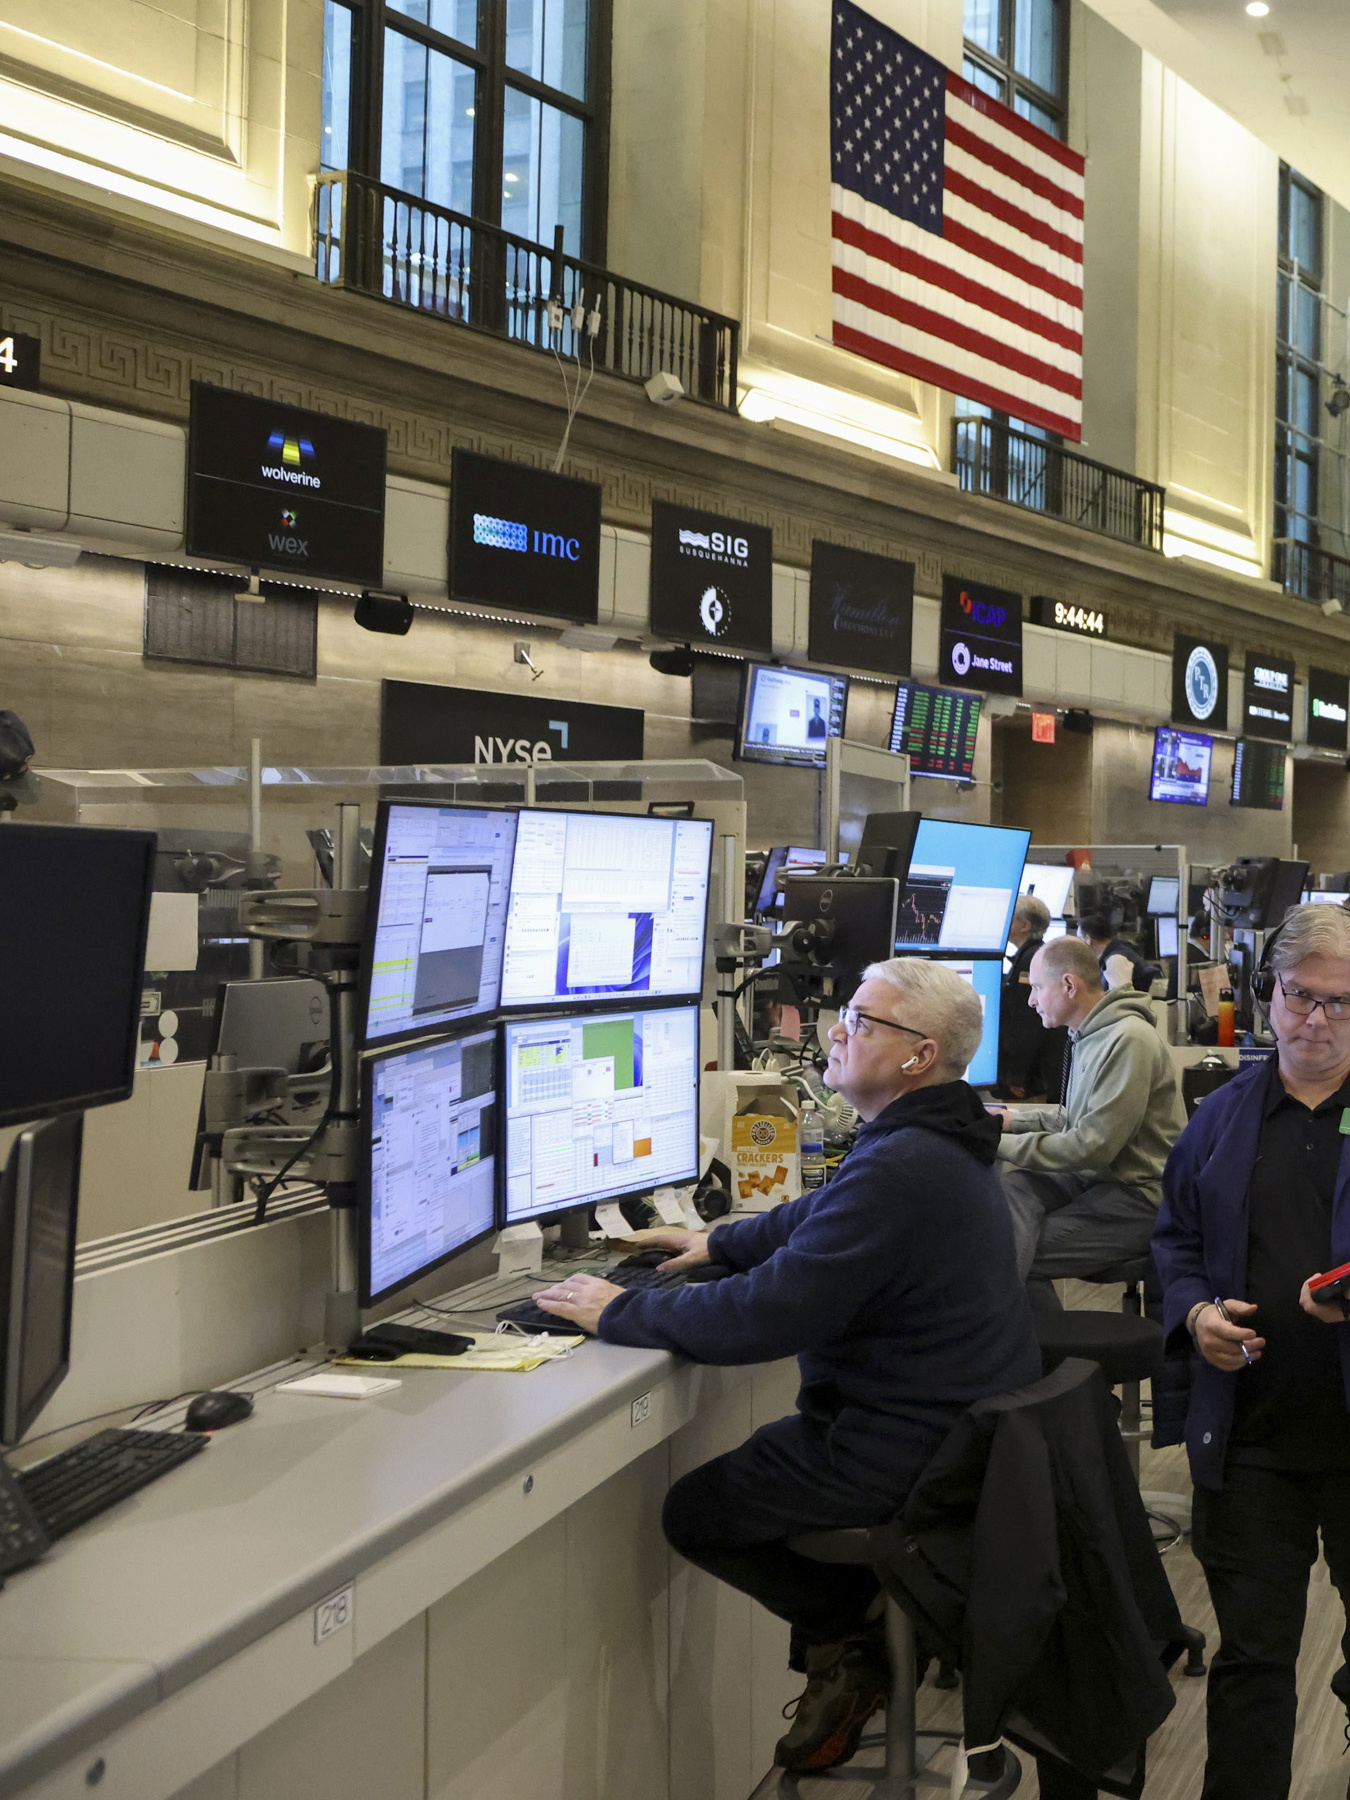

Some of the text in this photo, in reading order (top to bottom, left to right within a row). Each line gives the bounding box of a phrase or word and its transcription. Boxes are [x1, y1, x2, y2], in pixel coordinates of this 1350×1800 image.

[261, 465, 321, 489] wolverine
[268, 533, 309, 556] wex
[533, 530, 580, 562] imc
[679, 545, 749, 568] SUSQUEHANNA
[711, 531, 749, 558] SIG
[971, 601, 1007, 627] ICAP
[1054, 602, 1104, 634] 9:44:44
[971, 654, 1014, 674] Jane Street
[736, 1152, 784, 1164] CRACKERS
[634, 1396, 649, 1422] 219
[321, 1594, 347, 1635] 218
